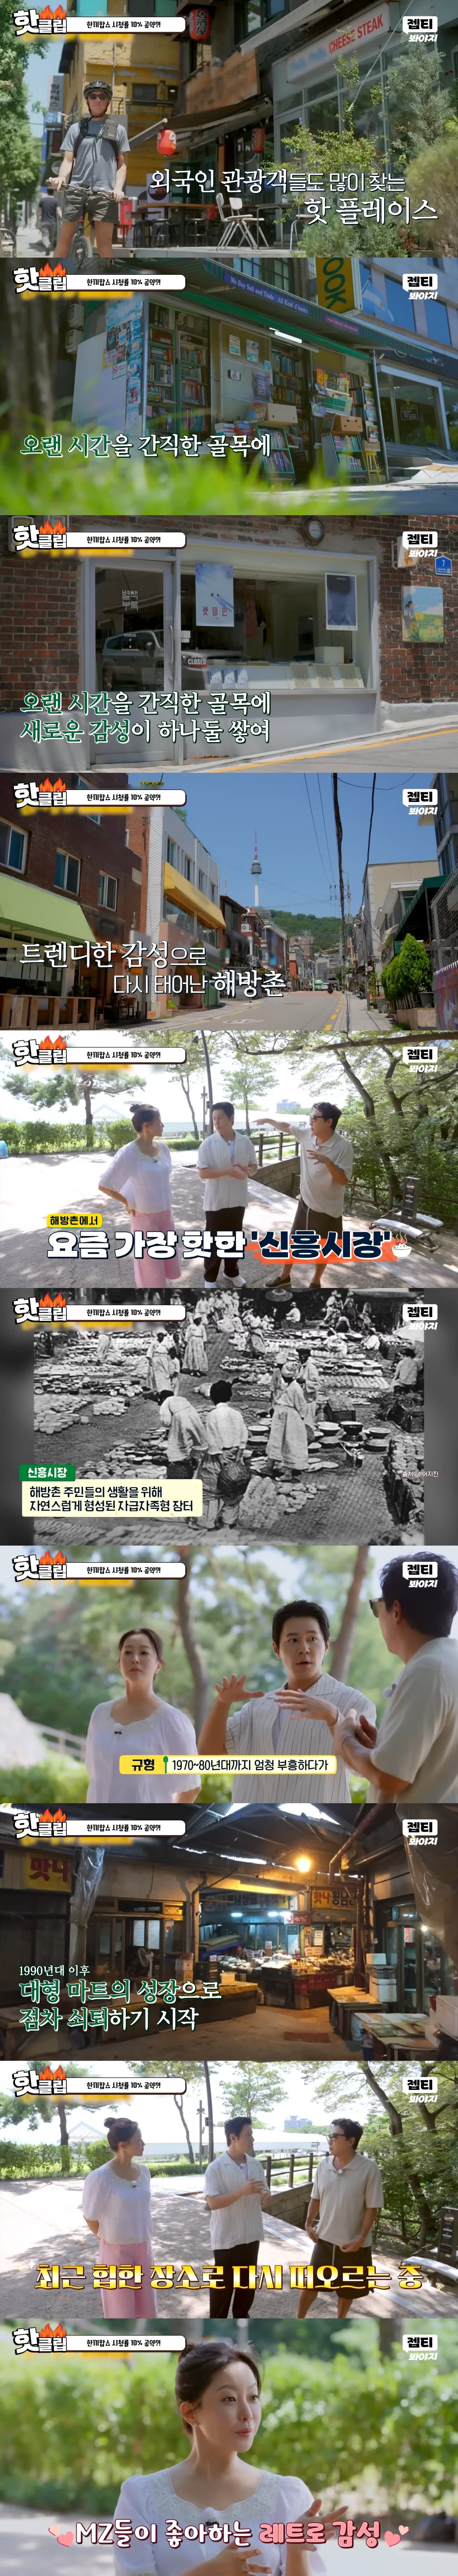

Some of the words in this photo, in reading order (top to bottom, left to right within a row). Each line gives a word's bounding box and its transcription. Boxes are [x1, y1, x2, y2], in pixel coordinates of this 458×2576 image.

[329, 29, 355, 53] CHEESE
[357, 14, 384, 39] STEAK
[323, 258, 346, 309] OOK
[264, 291, 274, 300] Trade
[298, 305, 308, 313] books
[122, 590, 138, 600] 별책
[122, 601, 138, 611] 부록
[29, 1858, 69, 1883] 맛나
[314, 1892, 331, 1904] 맛나
